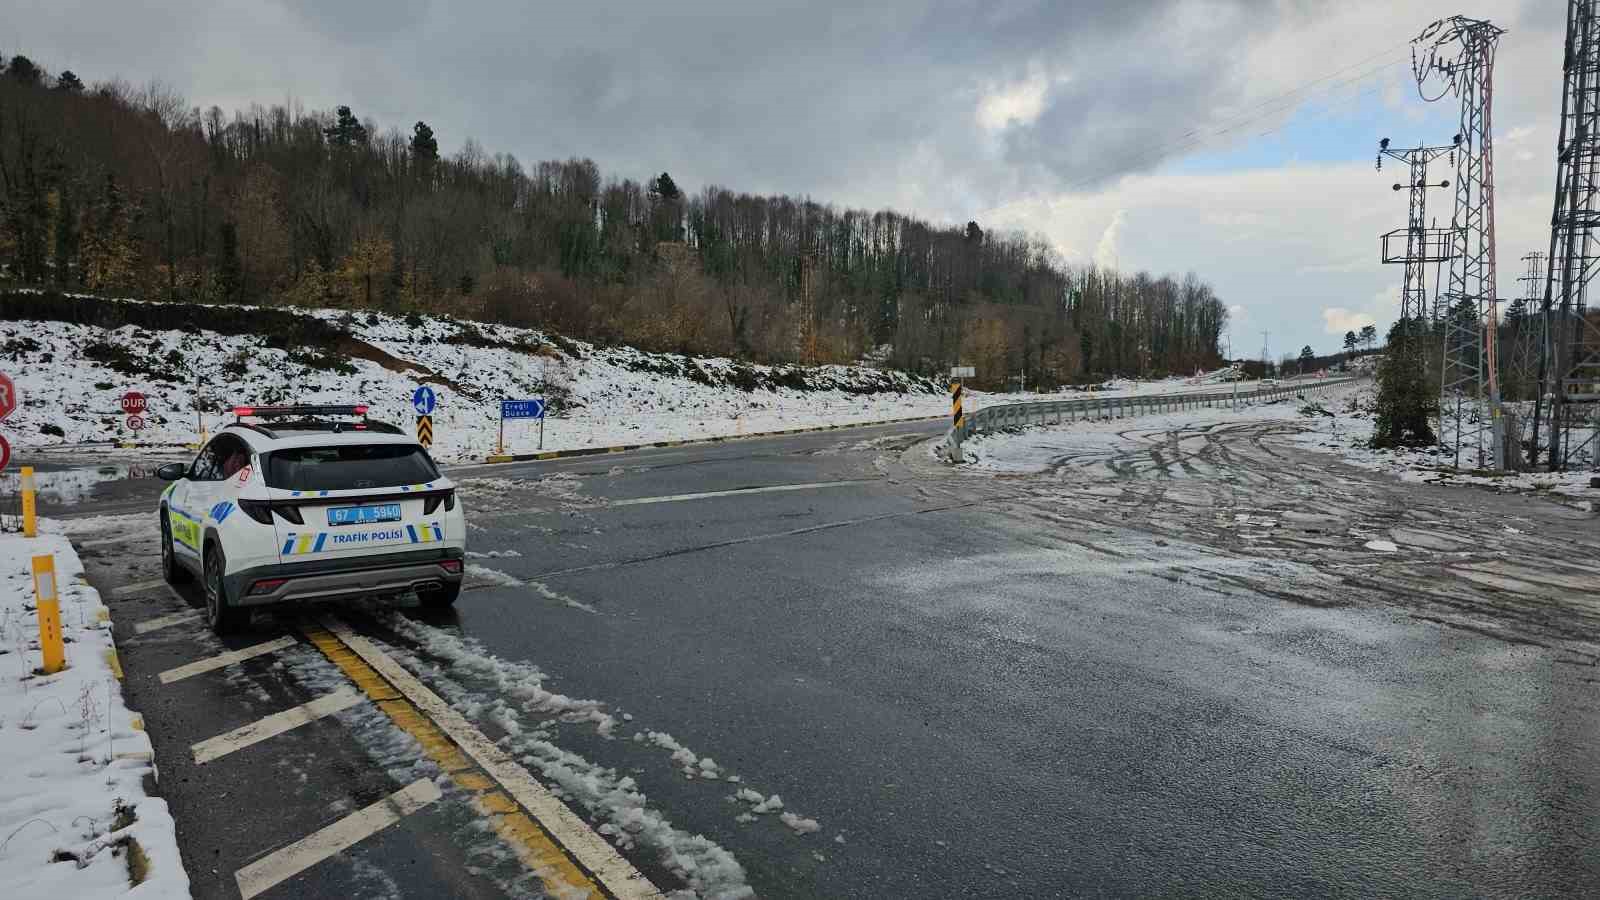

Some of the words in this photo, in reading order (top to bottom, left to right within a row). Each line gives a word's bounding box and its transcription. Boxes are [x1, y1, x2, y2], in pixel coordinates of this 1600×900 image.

[122, 399, 145, 408] DUR
[358, 508, 366, 519] A
[333, 532, 369, 544] TRAFİK
